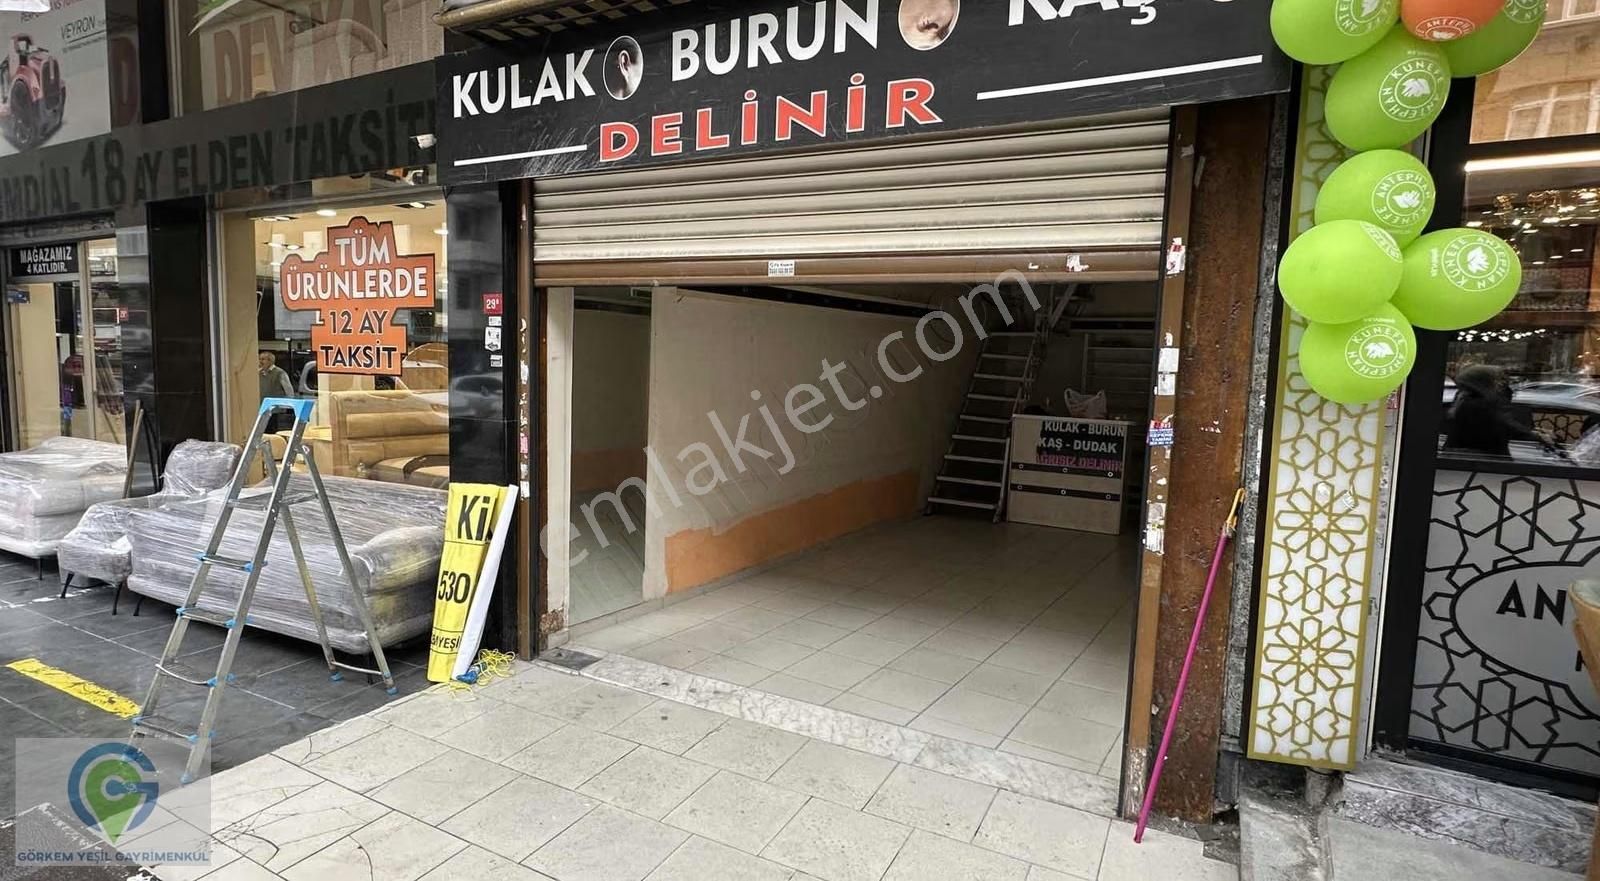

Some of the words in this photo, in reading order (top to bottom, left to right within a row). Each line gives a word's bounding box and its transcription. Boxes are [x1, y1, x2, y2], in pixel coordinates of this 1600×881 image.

[61, 15, 97, 39] VEYRON
[453, 48, 596, 118] KULAK
[671, 0, 880, 82] BURUN
[600, 72, 943, 162] DELİNİR
[81, 139, 127, 207] 18
[134, 150, 163, 207] AY
[174, 130, 274, 198] ELDEN
[20, 245, 72, 264] MAĞAZAMIZ
[335, 228, 391, 267] TÜM
[27, 263, 32, 274] 4
[286, 263, 428, 301] ÜRÜNLERDE
[329, 310, 353, 335] 12
[359, 310, 388, 335] AY
[320, 340, 398, 370] TAKSİT
[1044, 420, 1080, 434] KULAK
[1038, 436, 1063, 451] KAŞ
[1073, 440, 1118, 454] DUDAK
[438, 570, 471, 604] 530
[1496, 579, 1567, 627] AN
